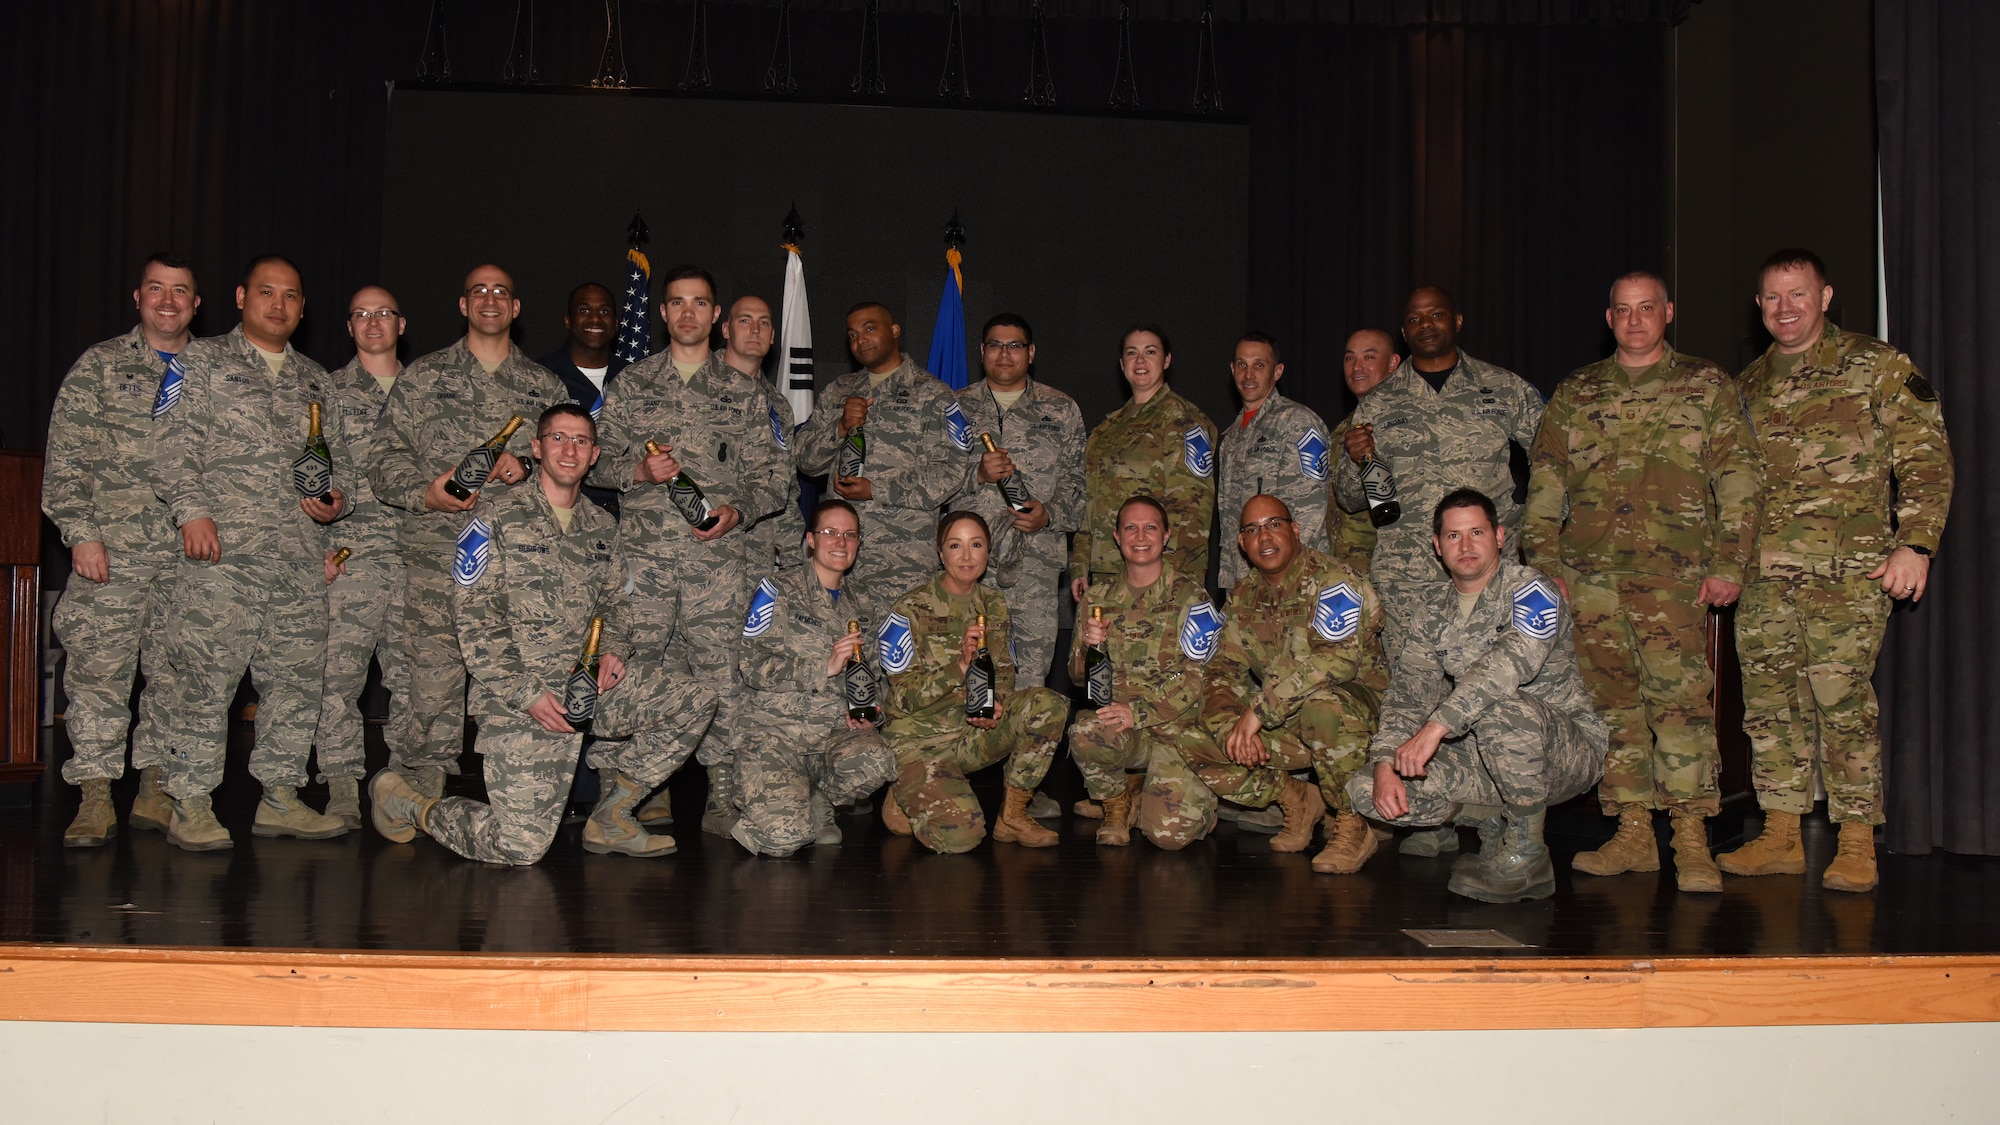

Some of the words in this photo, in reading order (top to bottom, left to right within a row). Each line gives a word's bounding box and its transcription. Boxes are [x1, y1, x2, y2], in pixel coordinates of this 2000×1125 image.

[225, 375, 250, 385] SANTOS
[1825, 379, 1848, 387] FORCE
[119, 383, 141, 392] BETTS
[1676, 386, 1685, 394] AIR
